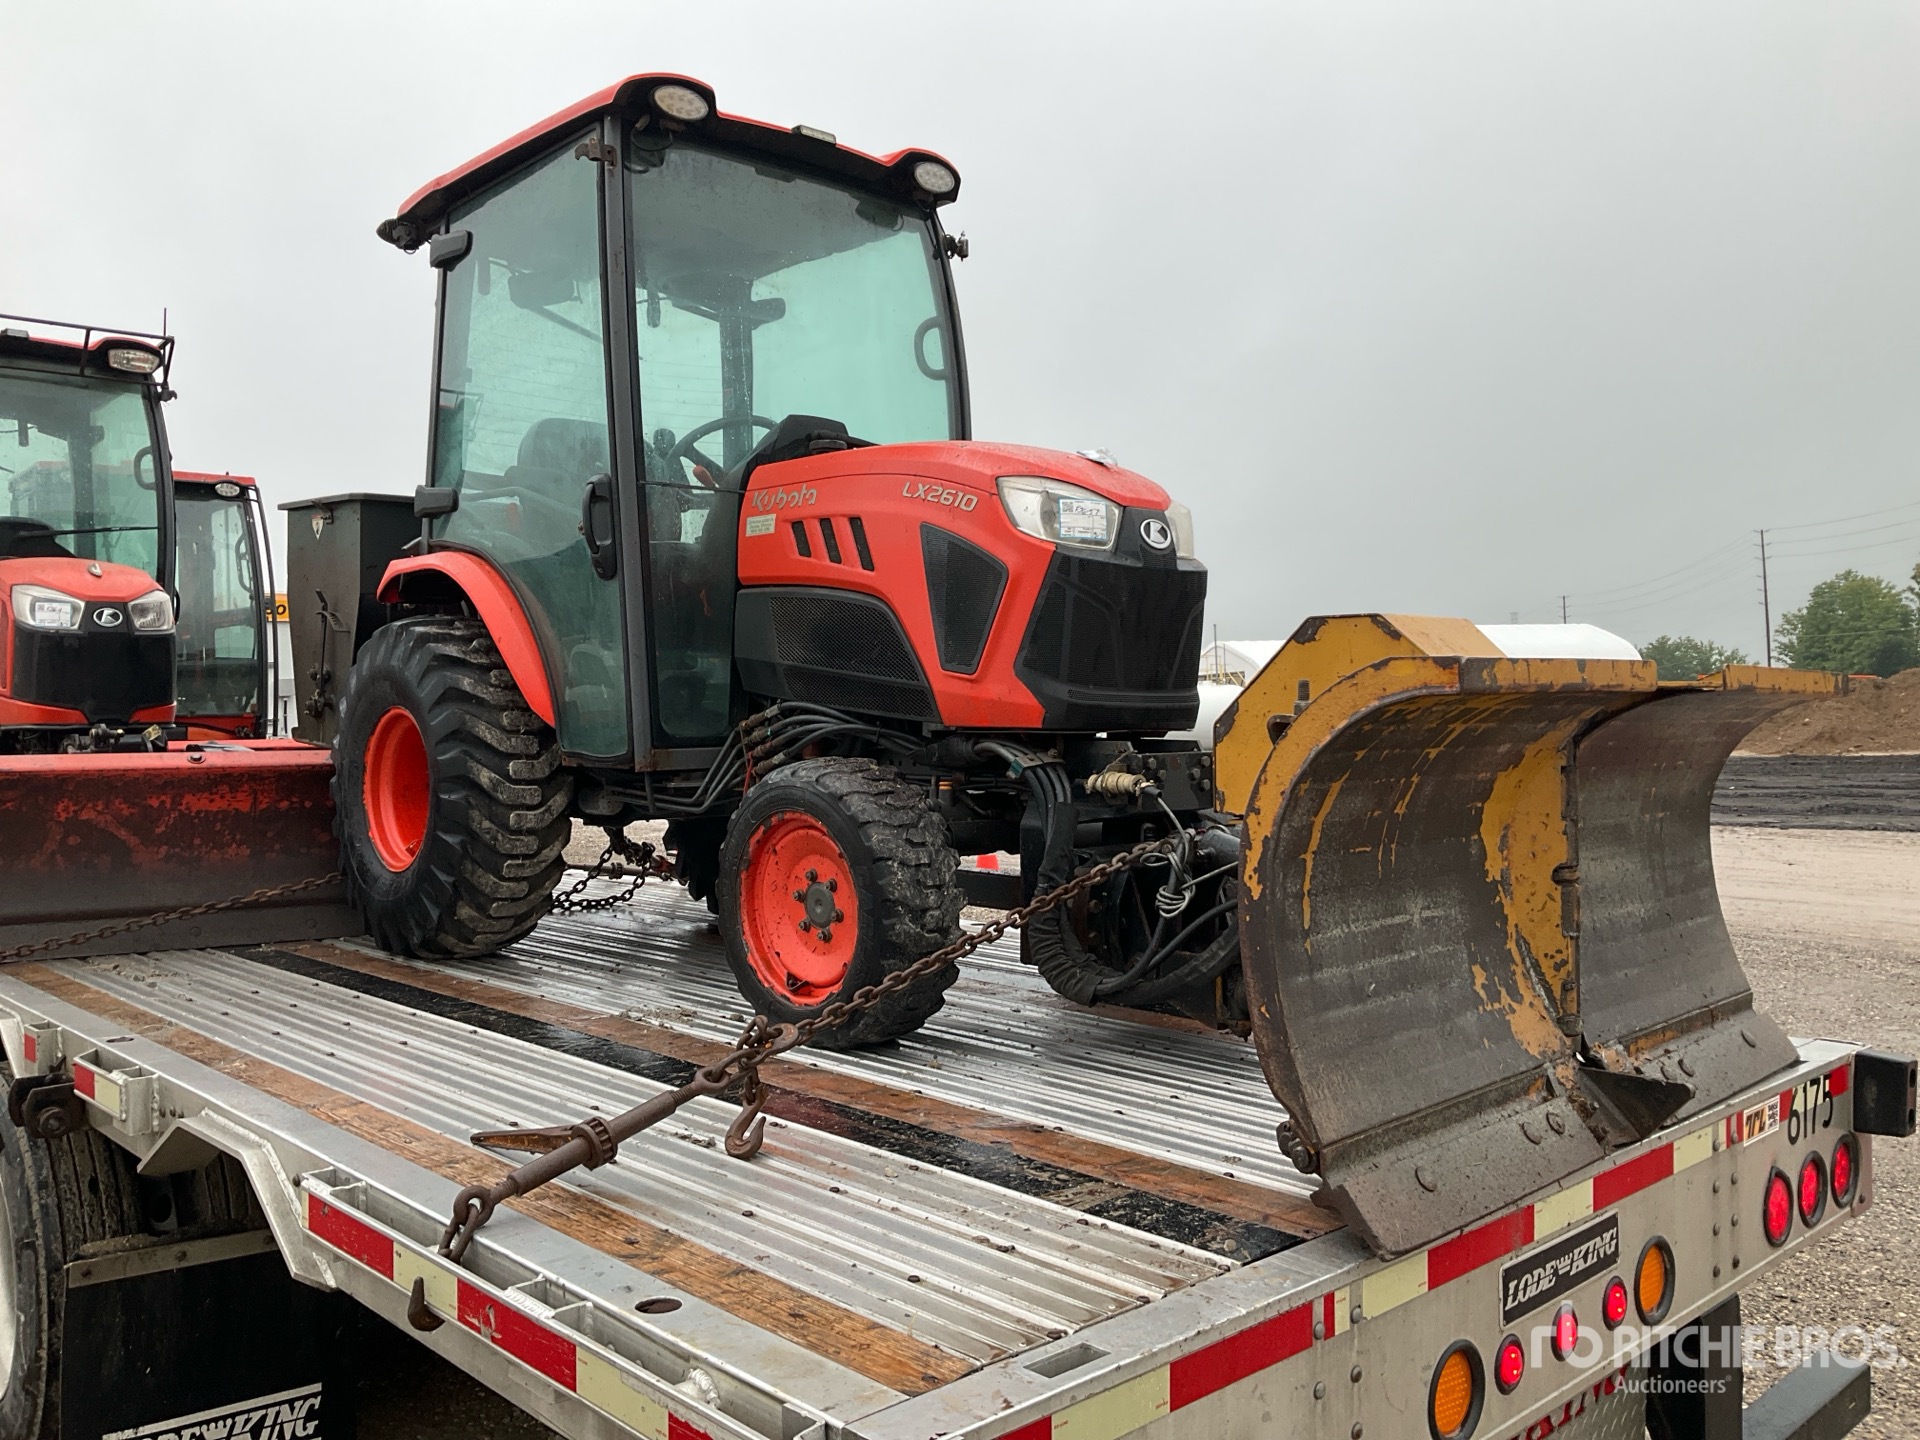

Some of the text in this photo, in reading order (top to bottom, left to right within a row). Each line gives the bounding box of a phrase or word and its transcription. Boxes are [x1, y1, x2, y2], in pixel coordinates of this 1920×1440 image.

[752, 483, 817, 512] Kubota
[902, 482, 979, 512] LX2610
[1787, 1073, 1834, 1146] 6175
